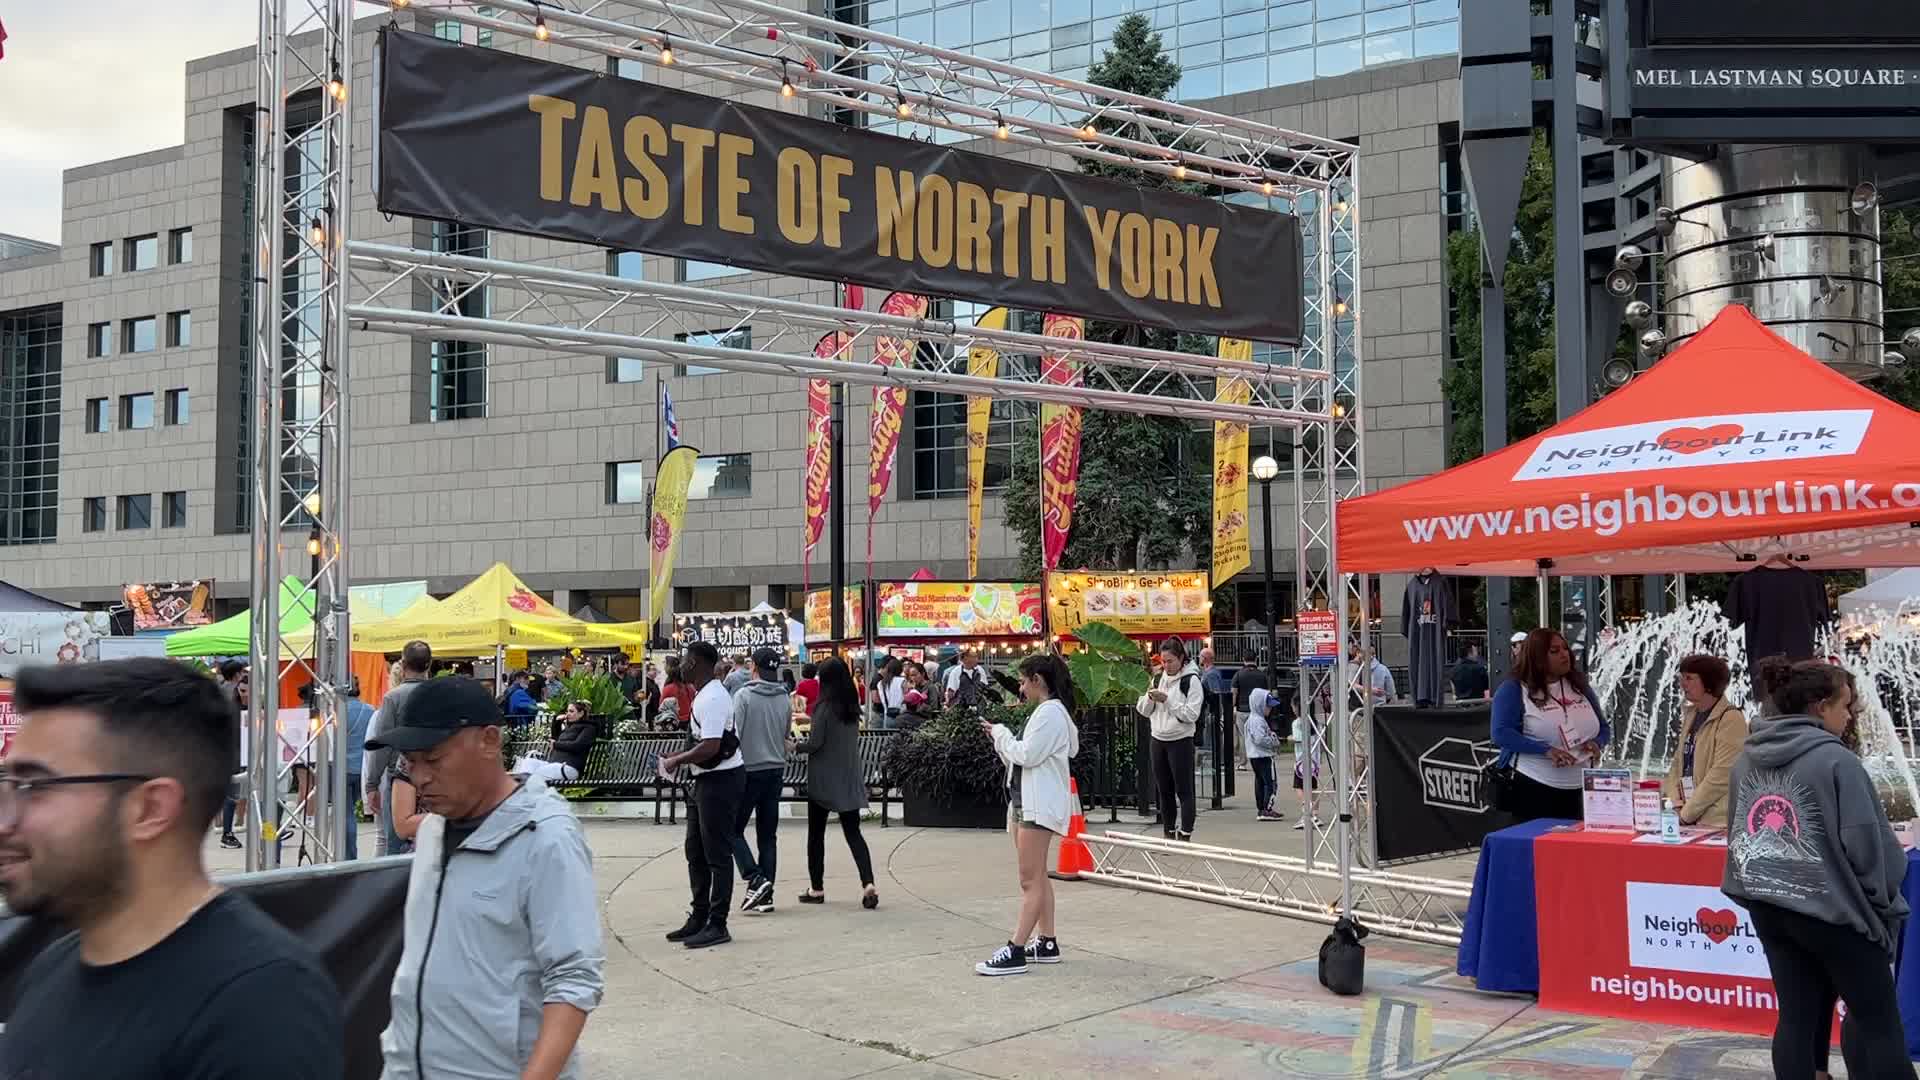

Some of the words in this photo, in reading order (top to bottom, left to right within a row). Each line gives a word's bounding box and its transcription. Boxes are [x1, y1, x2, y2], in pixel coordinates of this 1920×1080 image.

[1634, 69, 1682, 86] MEL
[1689, 69, 1803, 86] LASTMAN
[1811, 68, 1905, 88] SQUARE
[528, 94, 755, 235] TASTE
[777, 146, 854, 248] OF
[875, 165, 1066, 284] NORTH
[1083, 205, 1222, 307] YORK
[1546, 427, 1840, 462] NeighbourLink
[1218, 459, 1225, 470] 2
[1537, 455, 1673, 473] NORTH
[1718, 443, 1834, 457] YORK
[1216, 509, 1221, 520] 1
[1139, 576, 1193, 588] Ge-Pcket
[1425, 766, 1478, 804] STREET
[1644, 914, 1757, 939] NeighbourL
[1645, 937, 1712, 951] NORTH
[1731, 943, 1766, 955] YO
[1590, 974, 1779, 1011] neighbourlin
